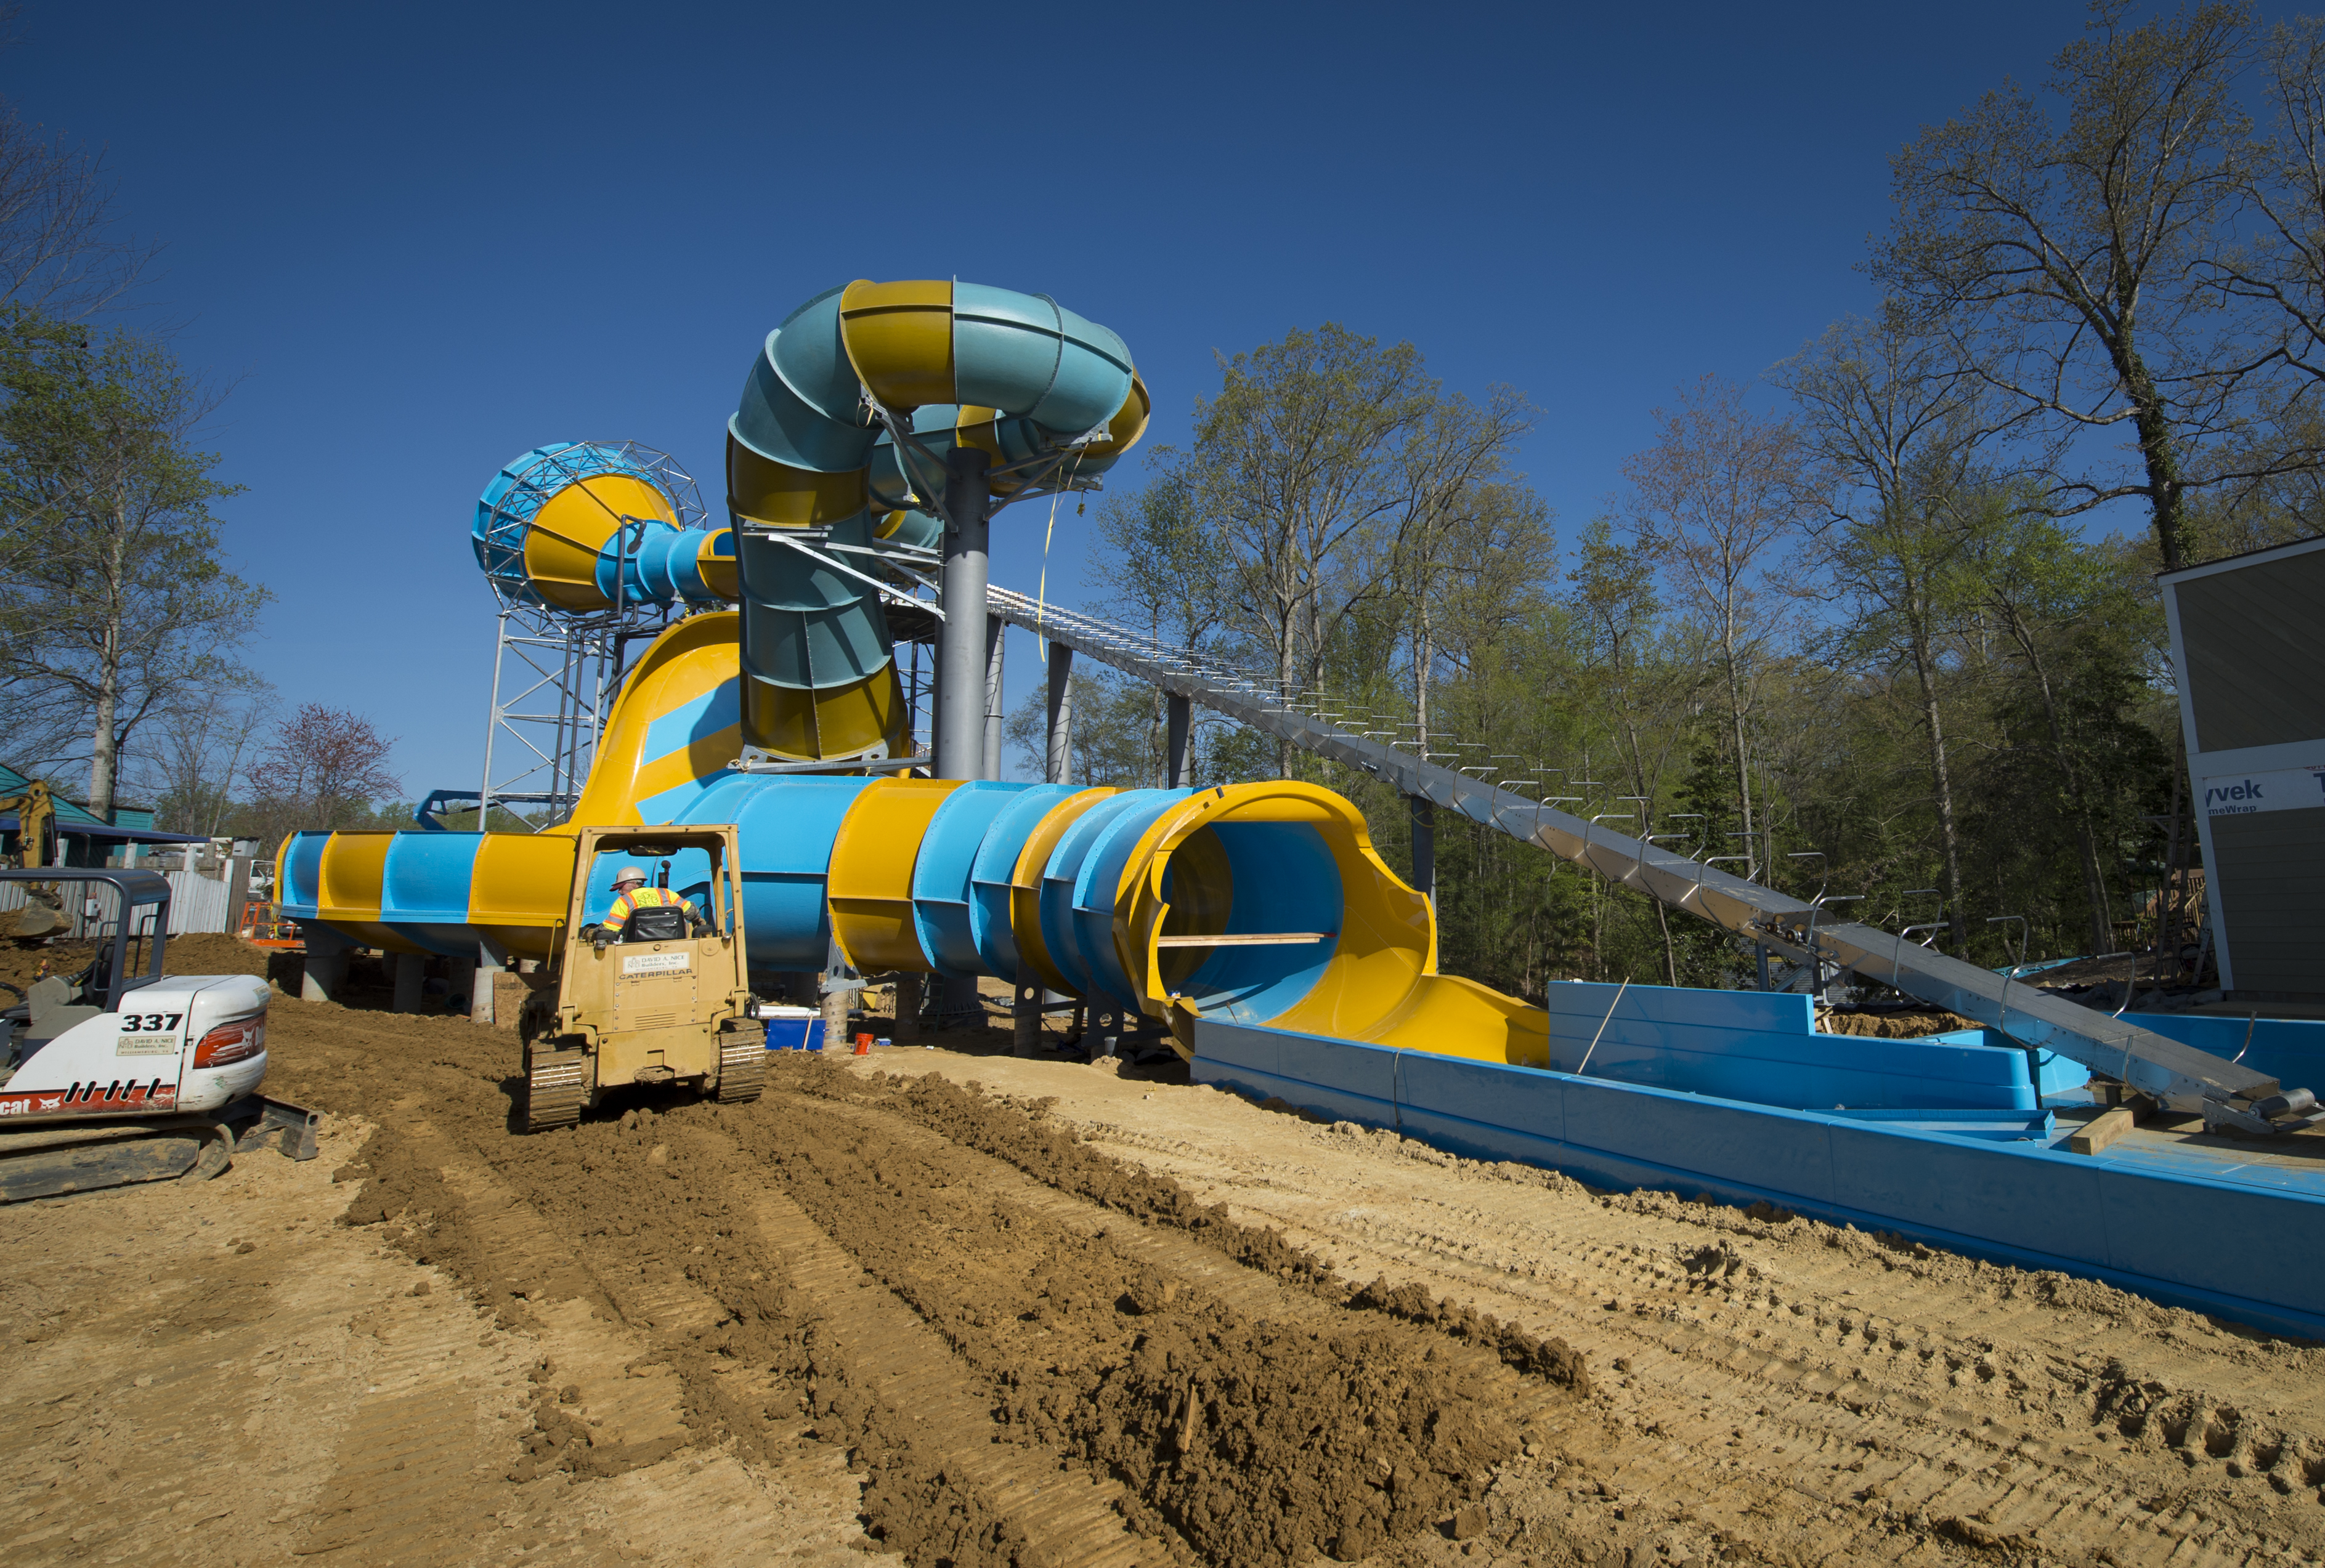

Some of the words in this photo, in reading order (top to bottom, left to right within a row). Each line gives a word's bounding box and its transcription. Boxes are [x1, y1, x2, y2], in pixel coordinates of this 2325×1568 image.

[619, 969, 692, 979] CATERPILLAR
[121, 1013, 183, 1032] 337
[0, 1099, 31, 1115] cat
